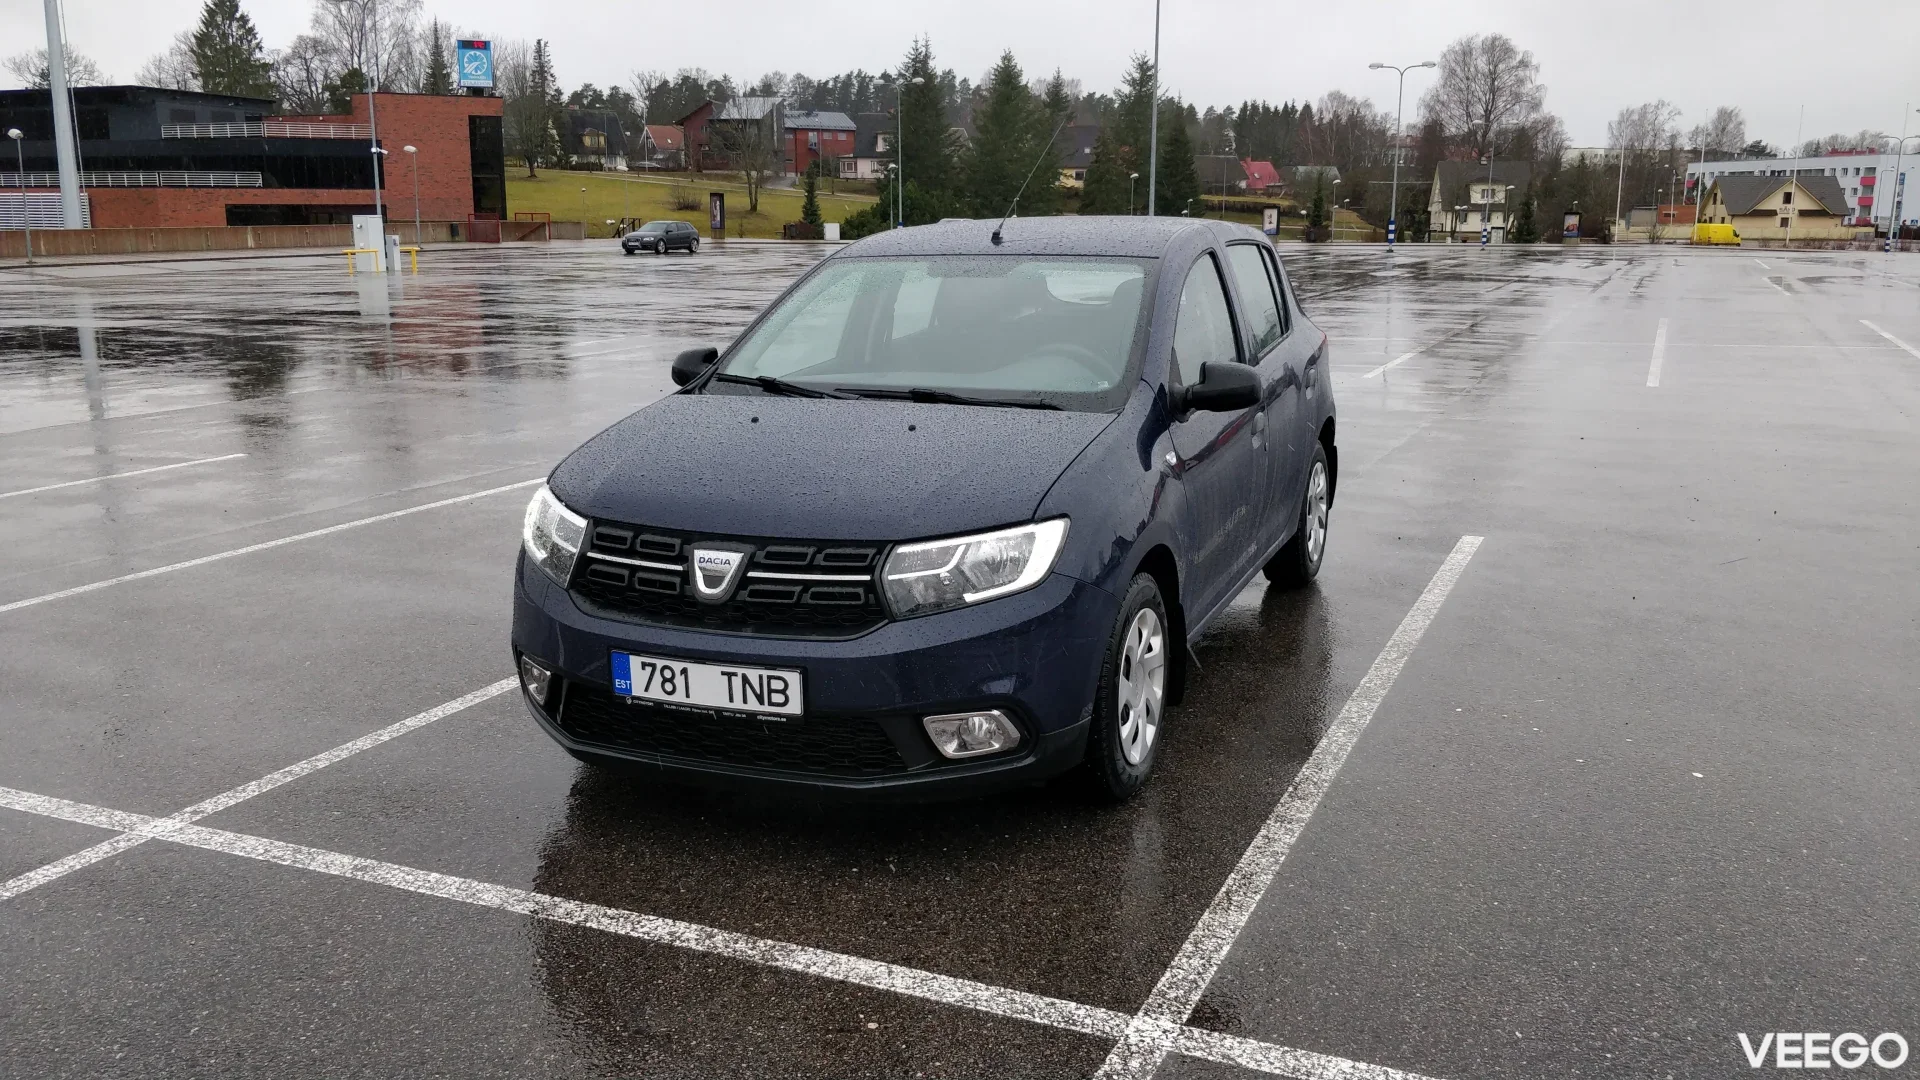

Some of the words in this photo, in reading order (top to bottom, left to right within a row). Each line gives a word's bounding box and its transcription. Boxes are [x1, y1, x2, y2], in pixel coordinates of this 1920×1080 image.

[698, 556, 731, 566] DACIA
[615, 679, 631, 689] EST
[641, 661, 690, 699] 781
[720, 670, 790, 708] TNB
